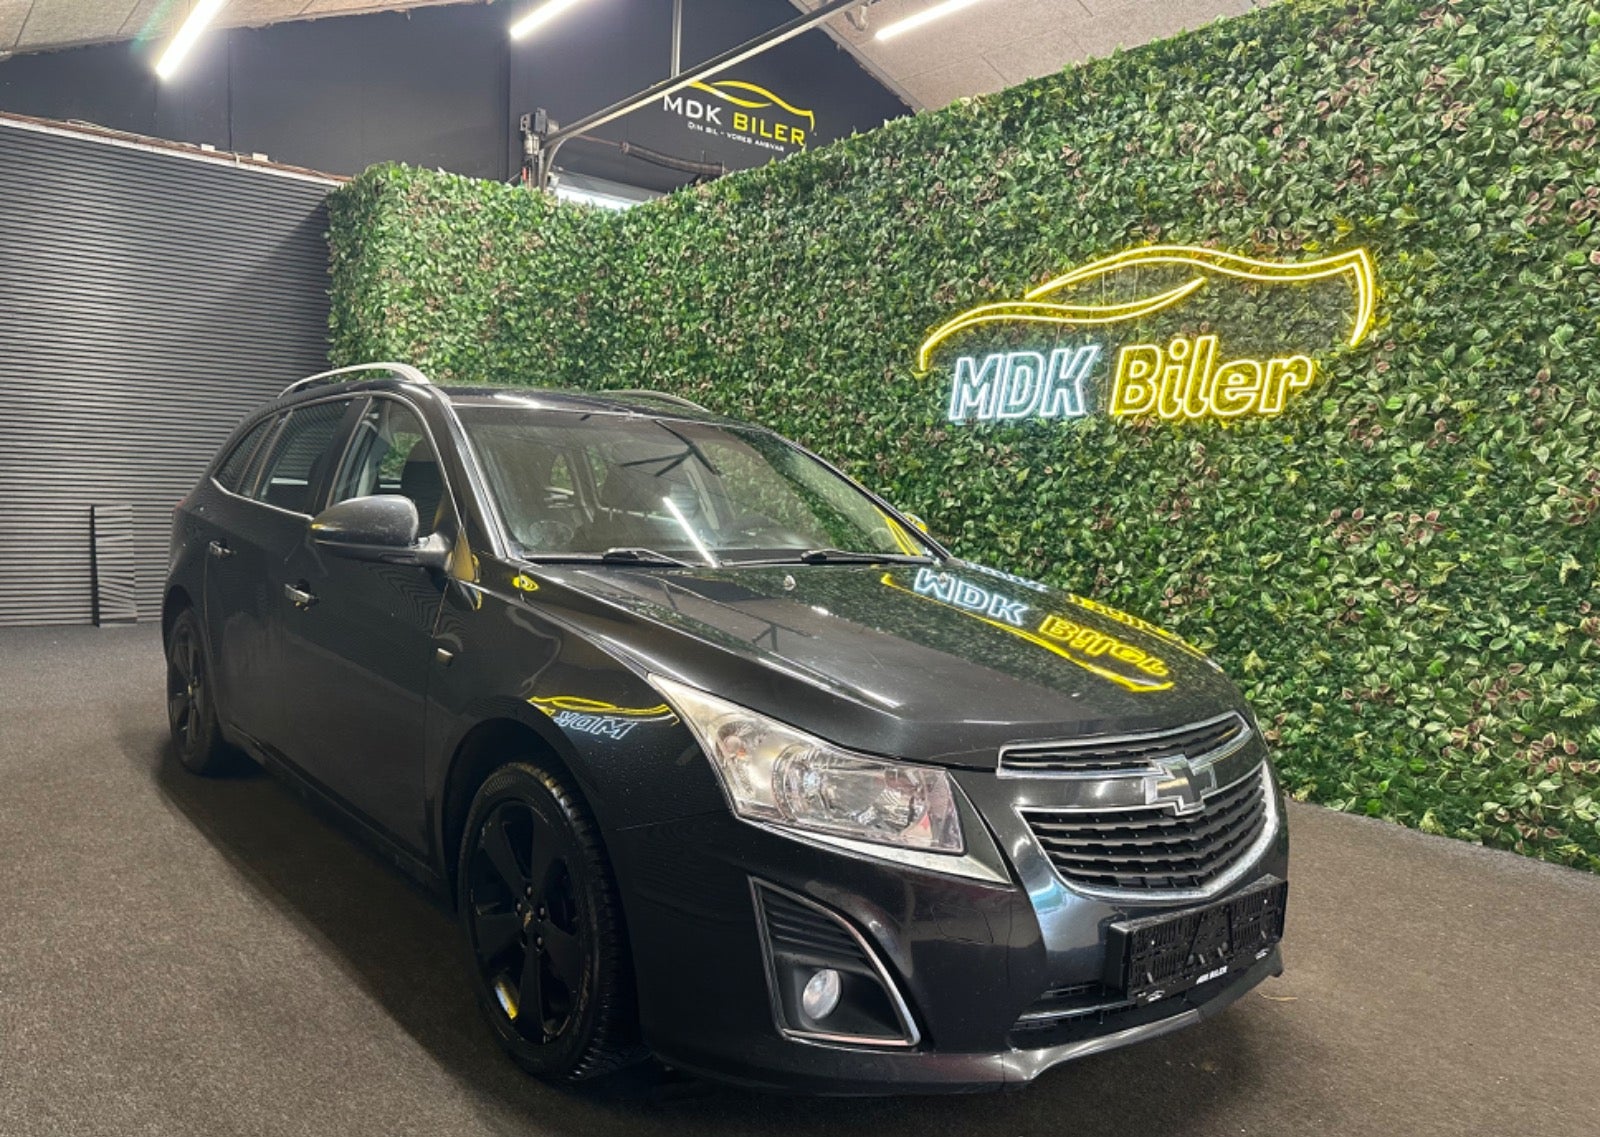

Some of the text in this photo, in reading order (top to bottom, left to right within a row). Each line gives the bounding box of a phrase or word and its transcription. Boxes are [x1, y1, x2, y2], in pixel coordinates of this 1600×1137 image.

[663, 95, 805, 146] MDK BILER
[949, 335, 1315, 421] MDK Biler
